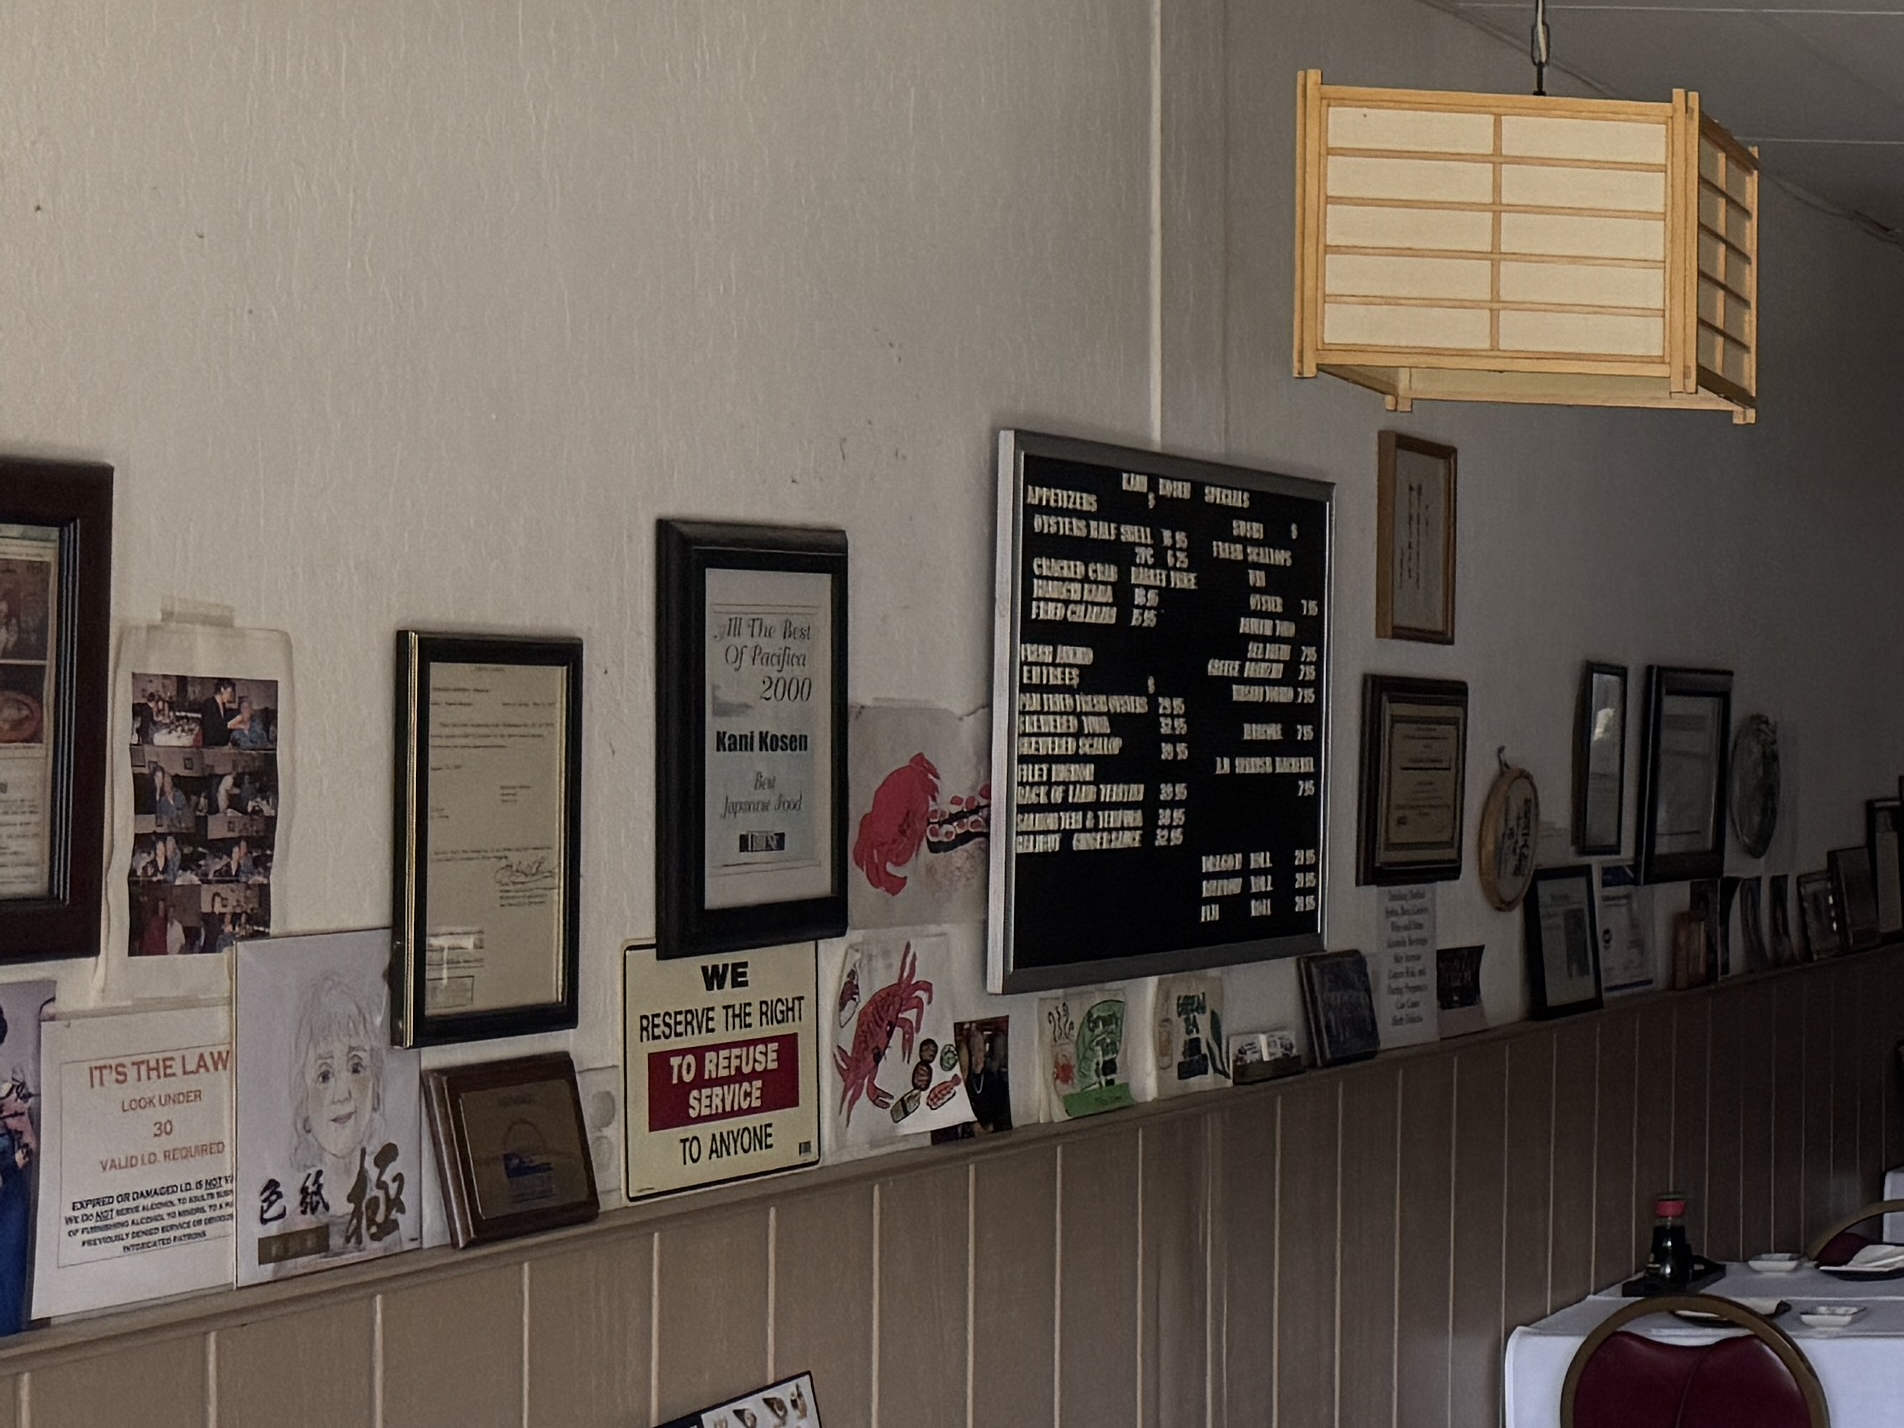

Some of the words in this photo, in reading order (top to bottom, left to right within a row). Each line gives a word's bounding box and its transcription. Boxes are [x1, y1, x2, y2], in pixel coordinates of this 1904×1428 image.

[1027, 484, 1097, 512] APPETIZERS
[1204, 485, 1250, 508] SPECIALS
[1034, 514, 1087, 537] OYSTERS
[1033, 557, 1085, 579] CRACKED
[1088, 562, 1118, 582] CRAB
[749, 617, 776, 640] The
[783, 618, 812, 641] Best
[725, 644, 748, 672] Of
[760, 676, 812, 702] 2000
[1023, 666, 1080, 688] ENTREES
[1019, 715, 1078, 734] SKEWERED
[715, 730, 754, 753] Kani
[759, 730, 808, 752] Kosen
[1079, 737, 1122, 755] SCALLOP
[1018, 764, 1049, 782] FILET
[701, 961, 749, 992] WE
[640, 1006, 715, 1043] RESERVE
[722, 1002, 752, 1032] THE
[759, 996, 805, 1027] RIGHT
[90, 1063, 127, 1089] IT'S
[132, 1057, 176, 1082] THE
[182, 1050, 230, 1073] LAW
[670, 1054, 697, 1084] TO
[704, 1042, 779, 1080] REFUSE
[122, 1094, 156, 1112] LOOK
[159, 1090, 203, 1108] UNDER
[689, 1080, 762, 1118] SERVICE
[153, 1121, 173, 1137] 30
[100, 1152, 138, 1172] VALID
[163, 1142, 225, 1162] REQUIRED
[680, 1136, 701, 1166] TO
[709, 1123, 773, 1160] ANYONE
[72, 1196, 114, 1211] EXPIRED
[118, 1192, 130, 1203] OR
[132, 1184, 179, 1201] DAMAGED
[205, 1177, 223, 1191] NOT
[96, 1208, 114, 1221] NOT
